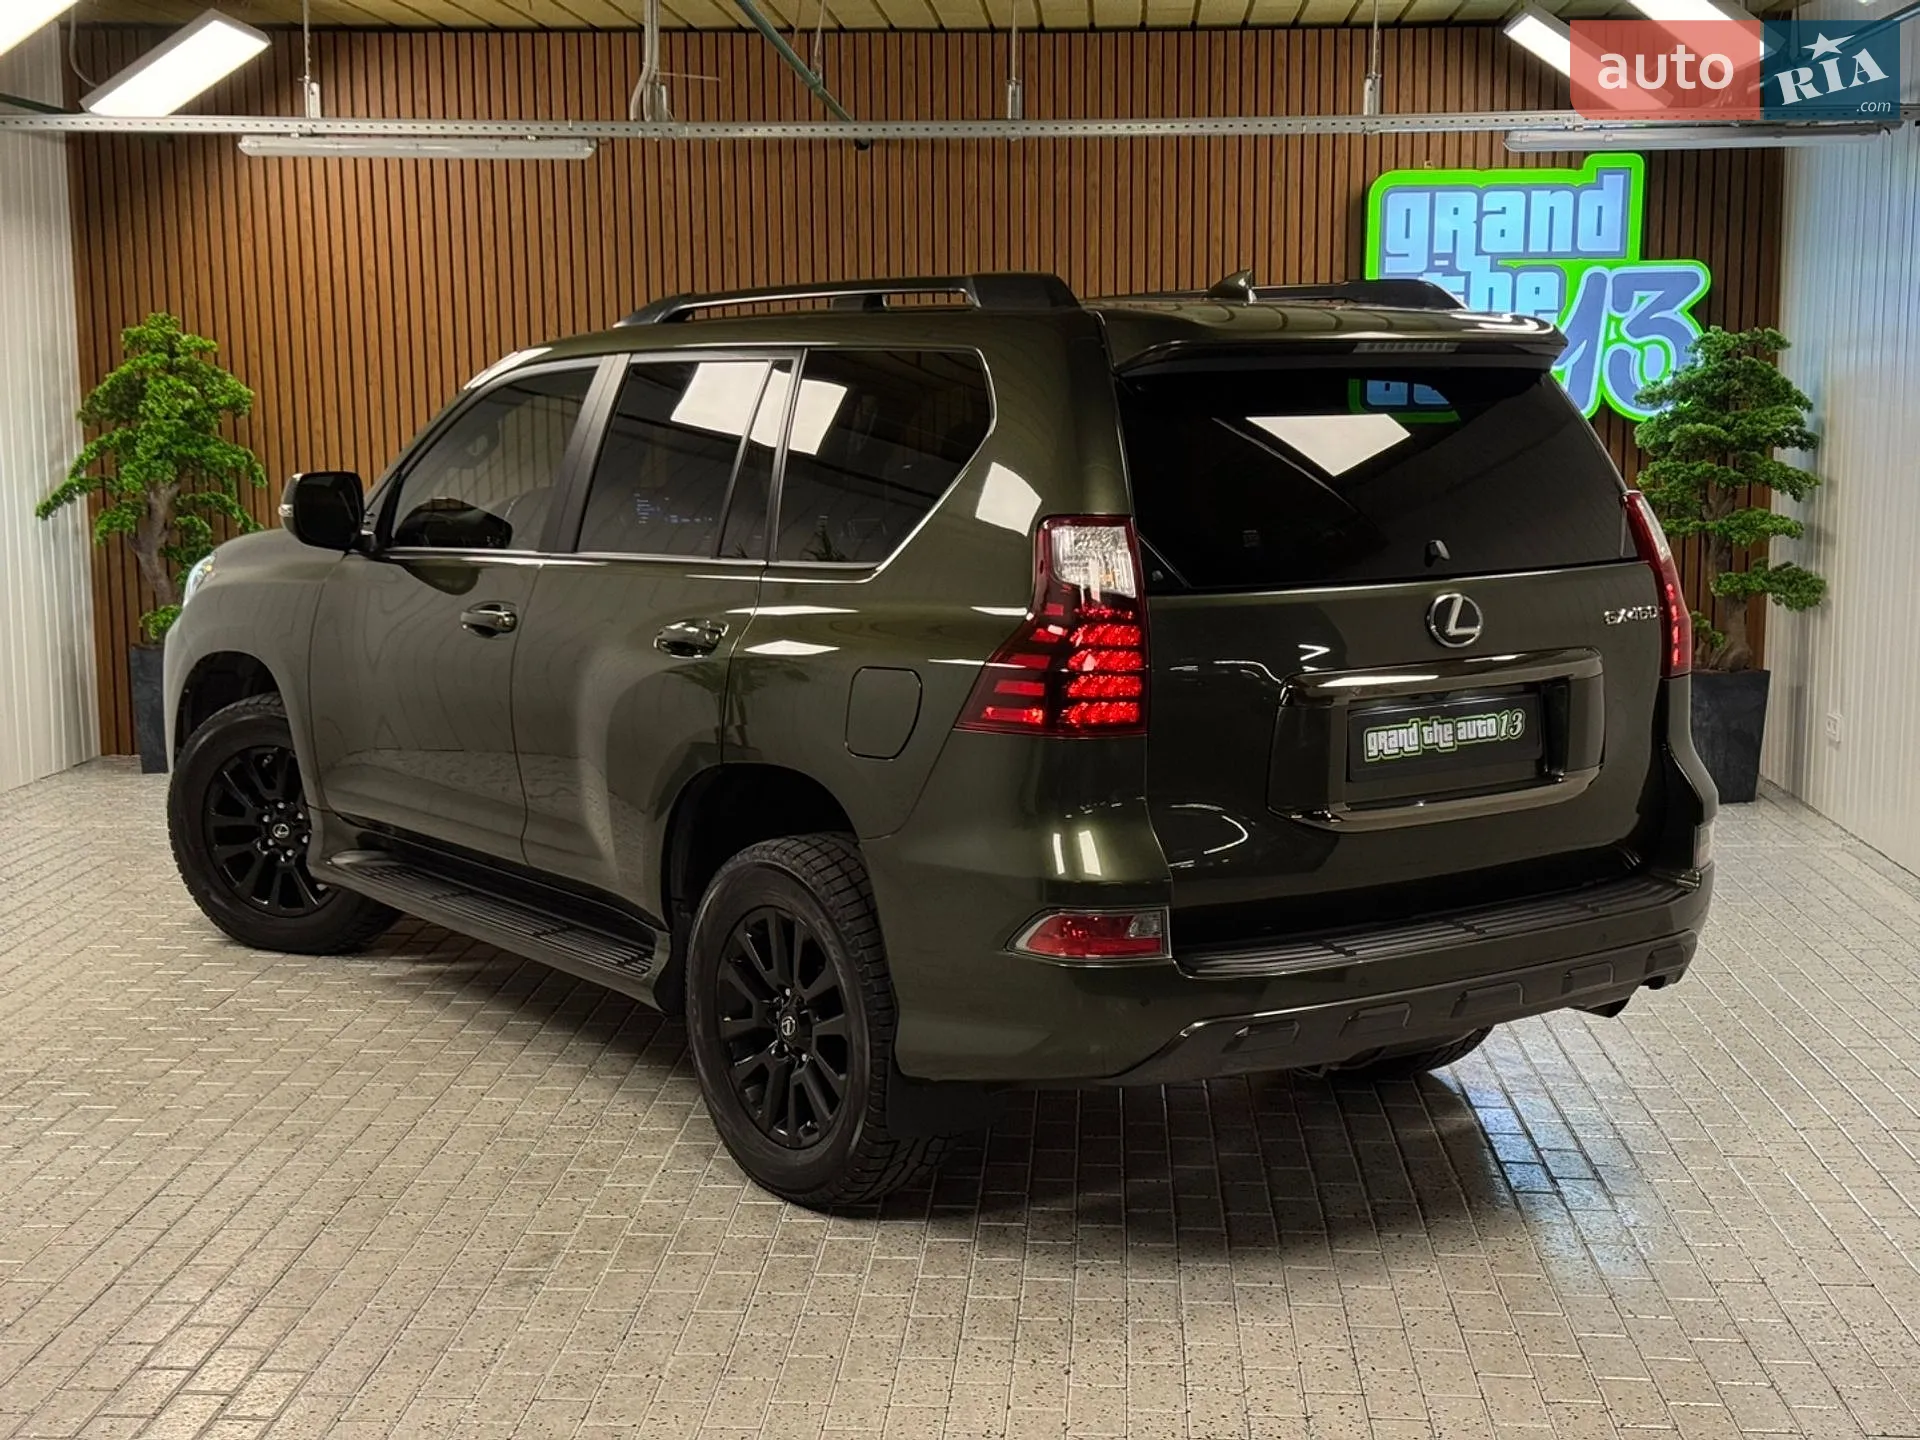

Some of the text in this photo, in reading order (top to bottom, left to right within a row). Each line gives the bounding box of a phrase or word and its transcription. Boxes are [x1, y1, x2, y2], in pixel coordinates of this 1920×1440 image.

[1553, 266, 1707, 412] 13
[1366, 721, 1420, 758] grand
[1422, 719, 1454, 748] the
